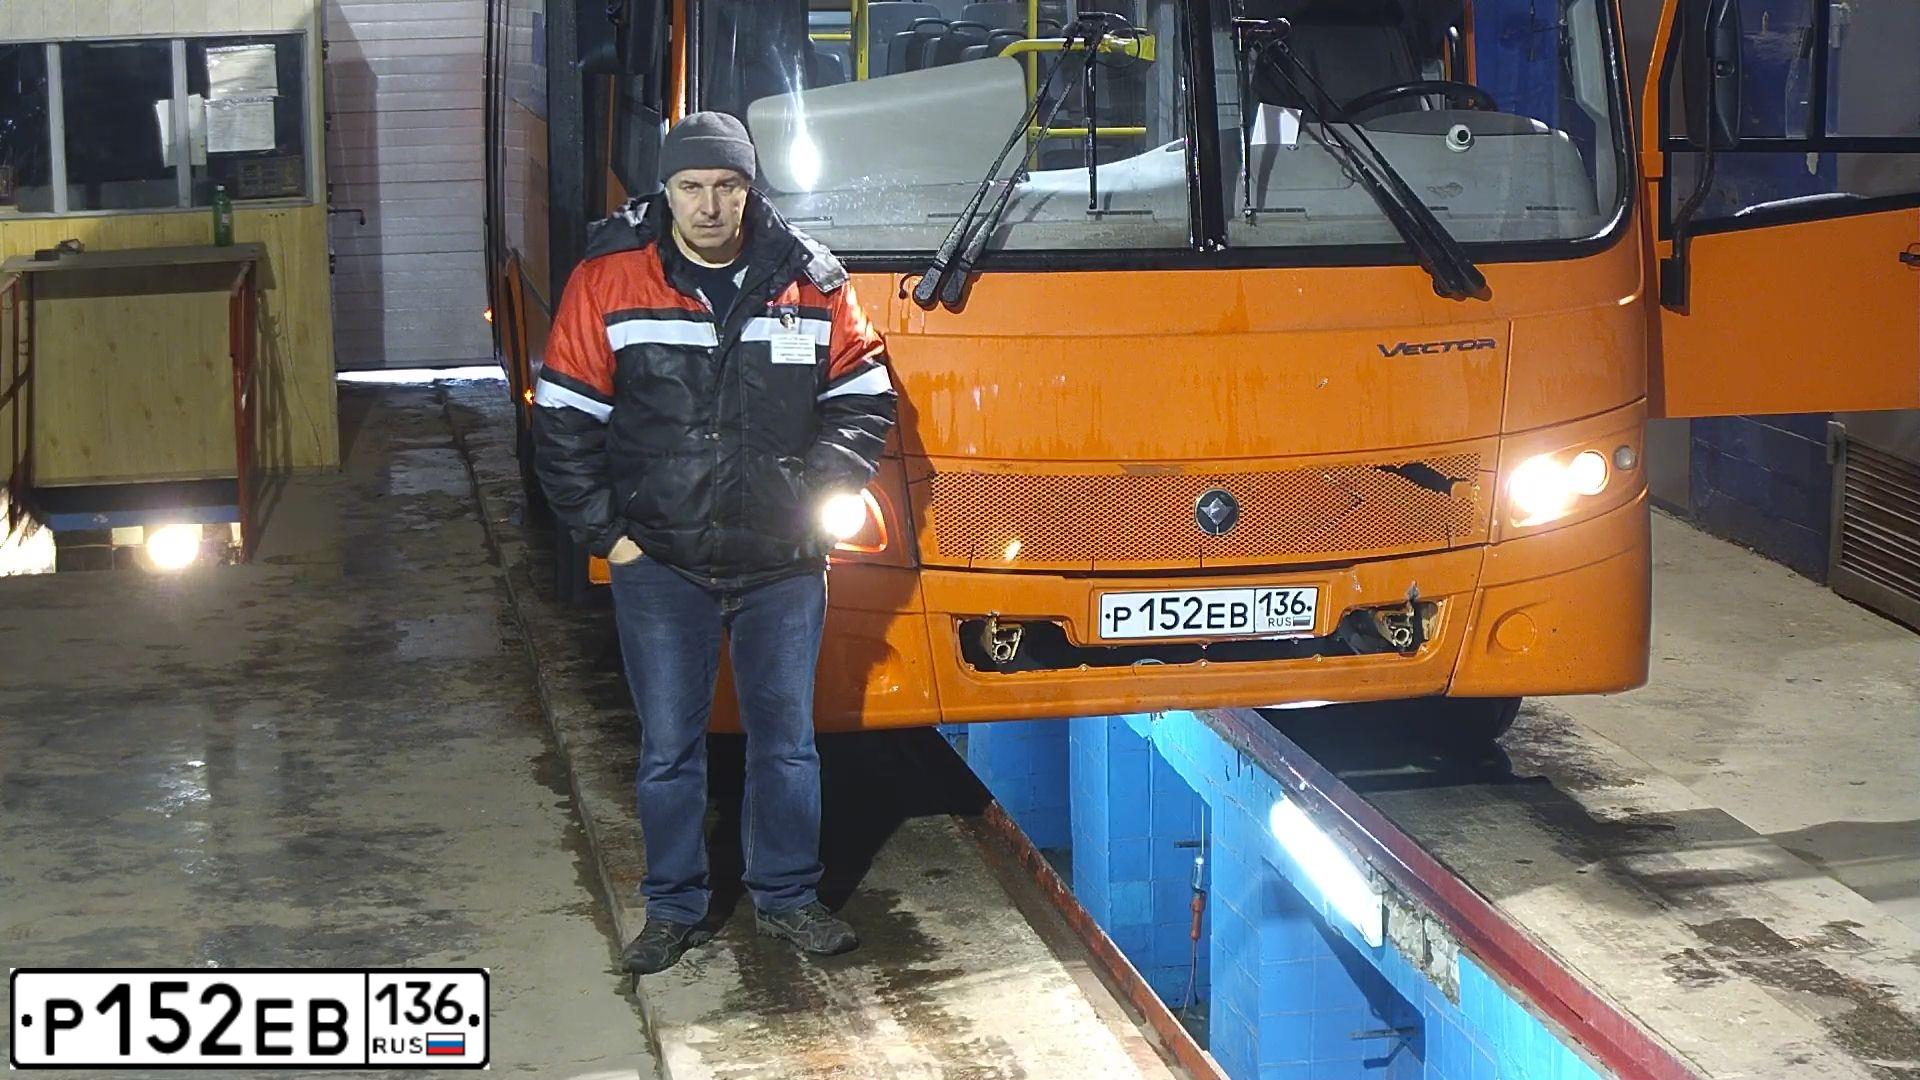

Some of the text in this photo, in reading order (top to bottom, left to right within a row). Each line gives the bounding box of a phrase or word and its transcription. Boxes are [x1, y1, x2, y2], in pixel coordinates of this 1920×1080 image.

[1377, 338, 1496, 357] VECTOR
[1258, 591, 1306, 617] 136
[1268, 616, 1292, 627] RUS
